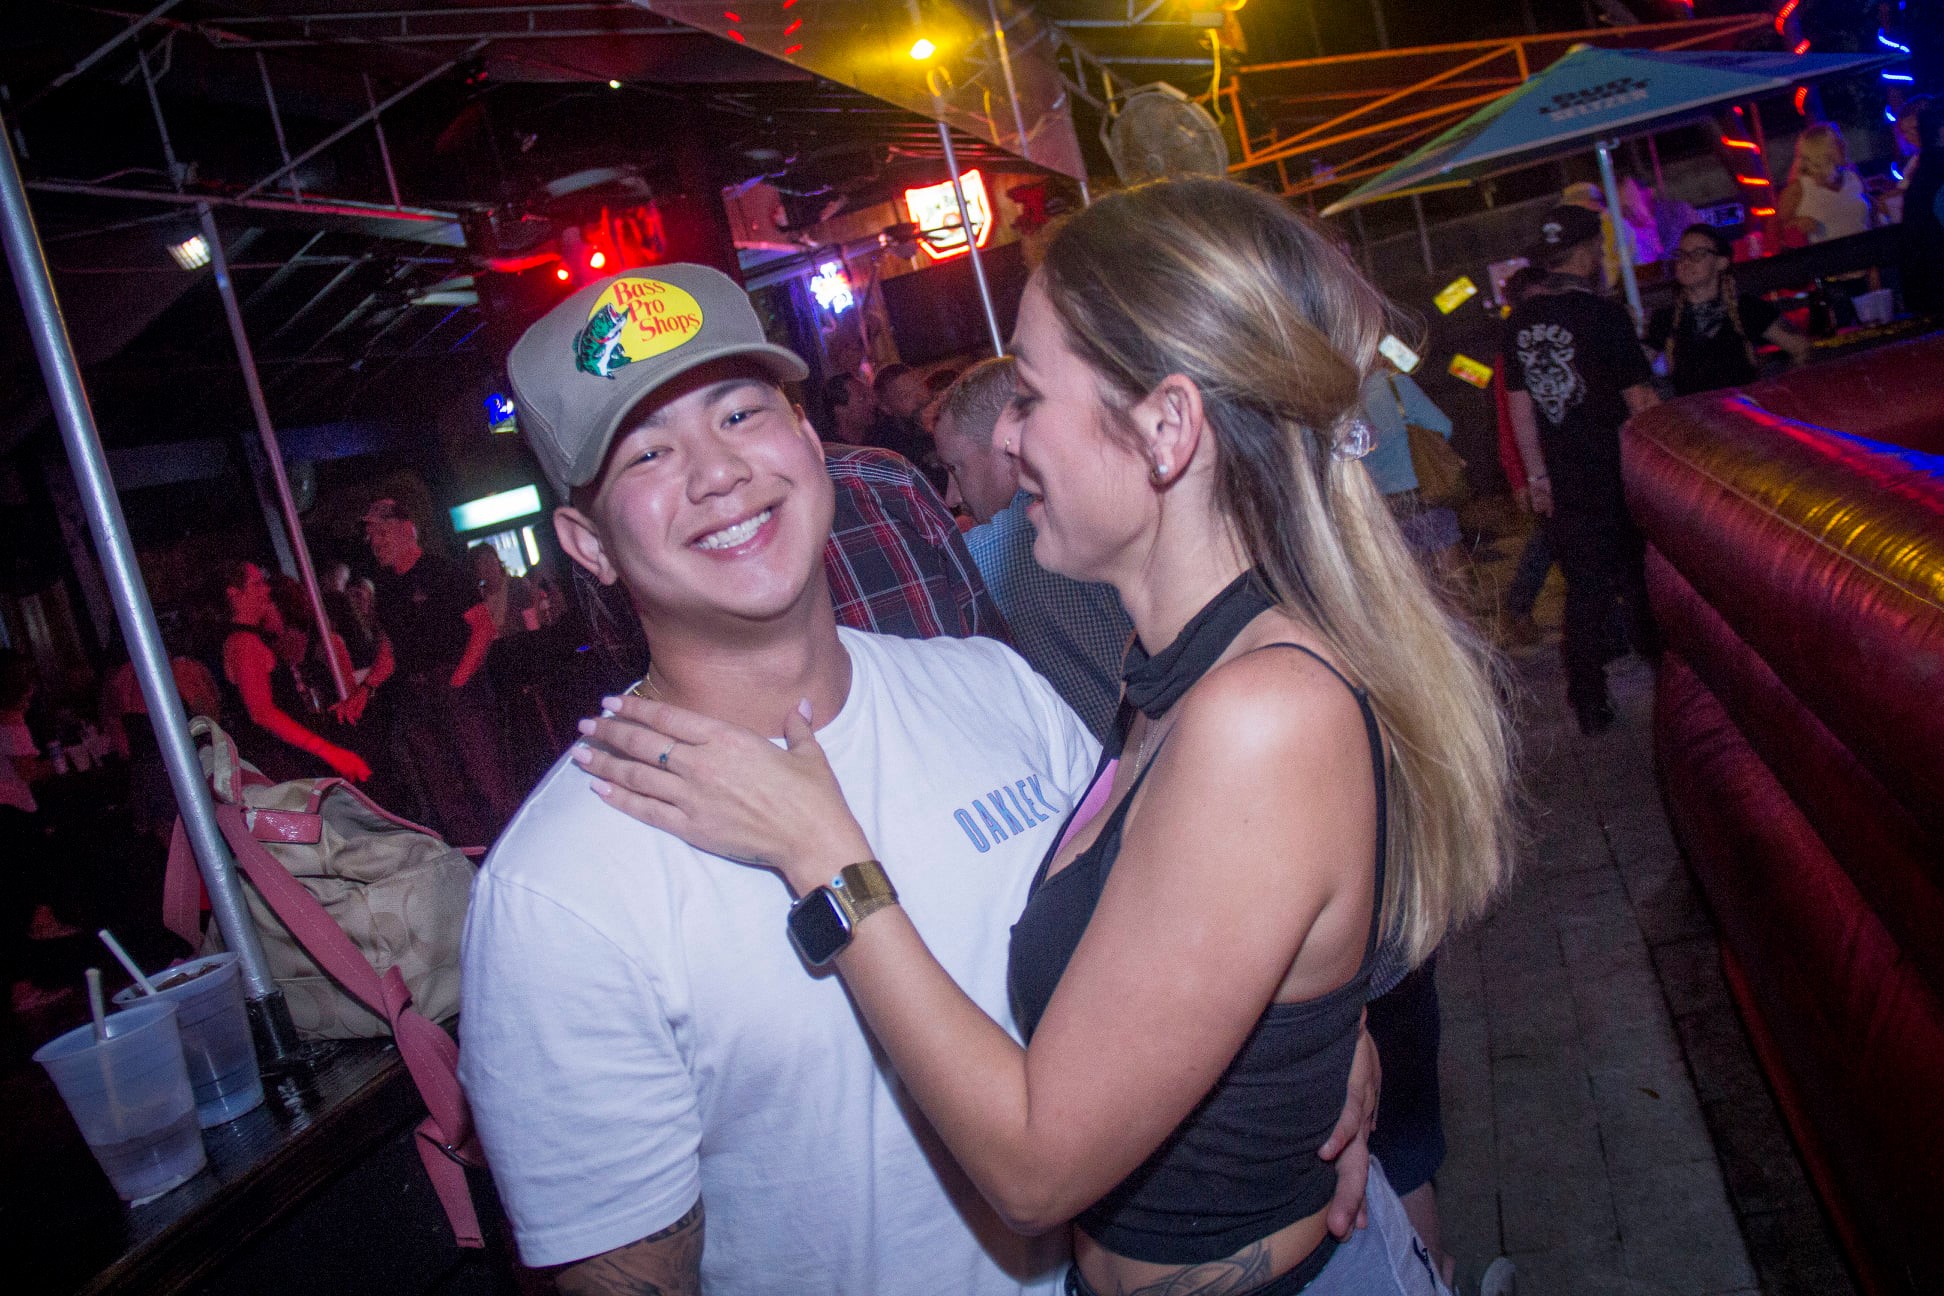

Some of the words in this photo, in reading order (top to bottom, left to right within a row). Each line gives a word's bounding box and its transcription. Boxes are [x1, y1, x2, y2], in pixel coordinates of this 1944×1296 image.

[612, 281, 666, 307] Bass
[627, 299, 665, 323] Pro
[639, 313, 701, 342] Shops
[953, 774, 1060, 853] OAKLEY
